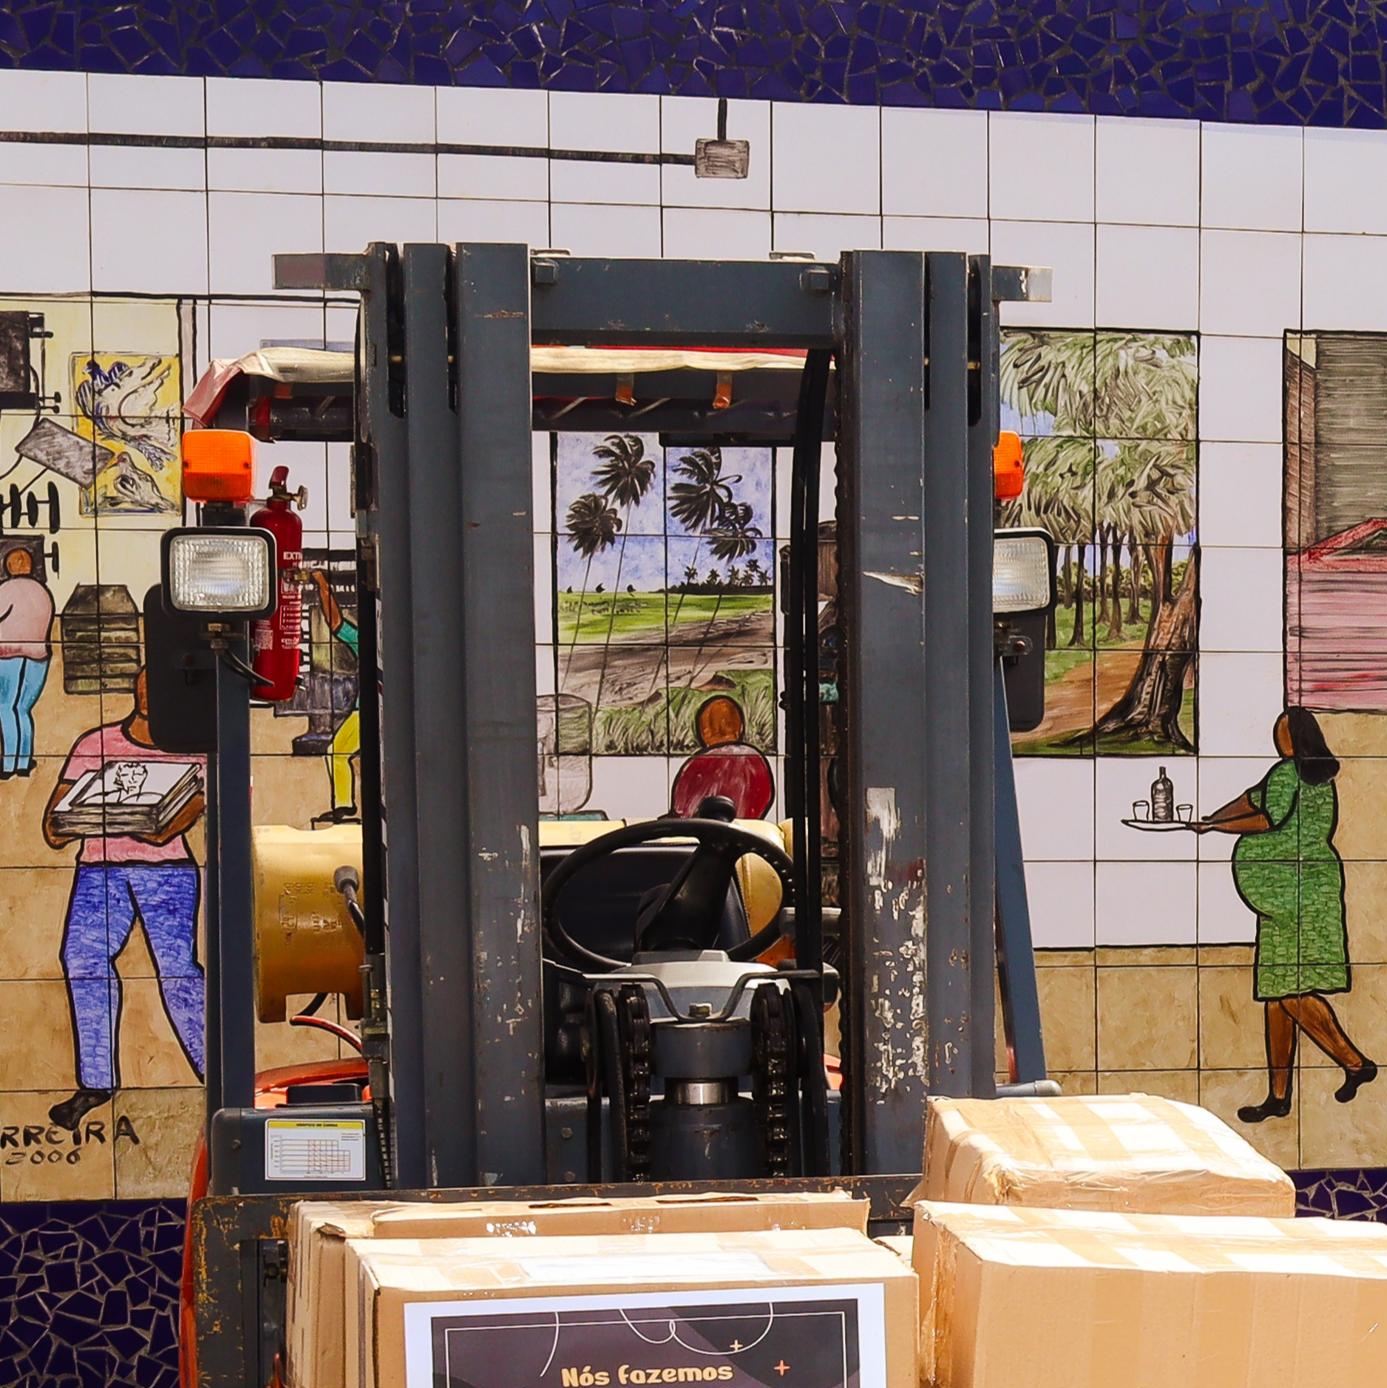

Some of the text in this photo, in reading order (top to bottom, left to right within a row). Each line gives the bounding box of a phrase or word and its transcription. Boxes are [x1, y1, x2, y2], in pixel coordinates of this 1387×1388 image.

[5, 1148, 82, 1165] 2006
[561, 1364, 733, 1387] Nós fazemos
